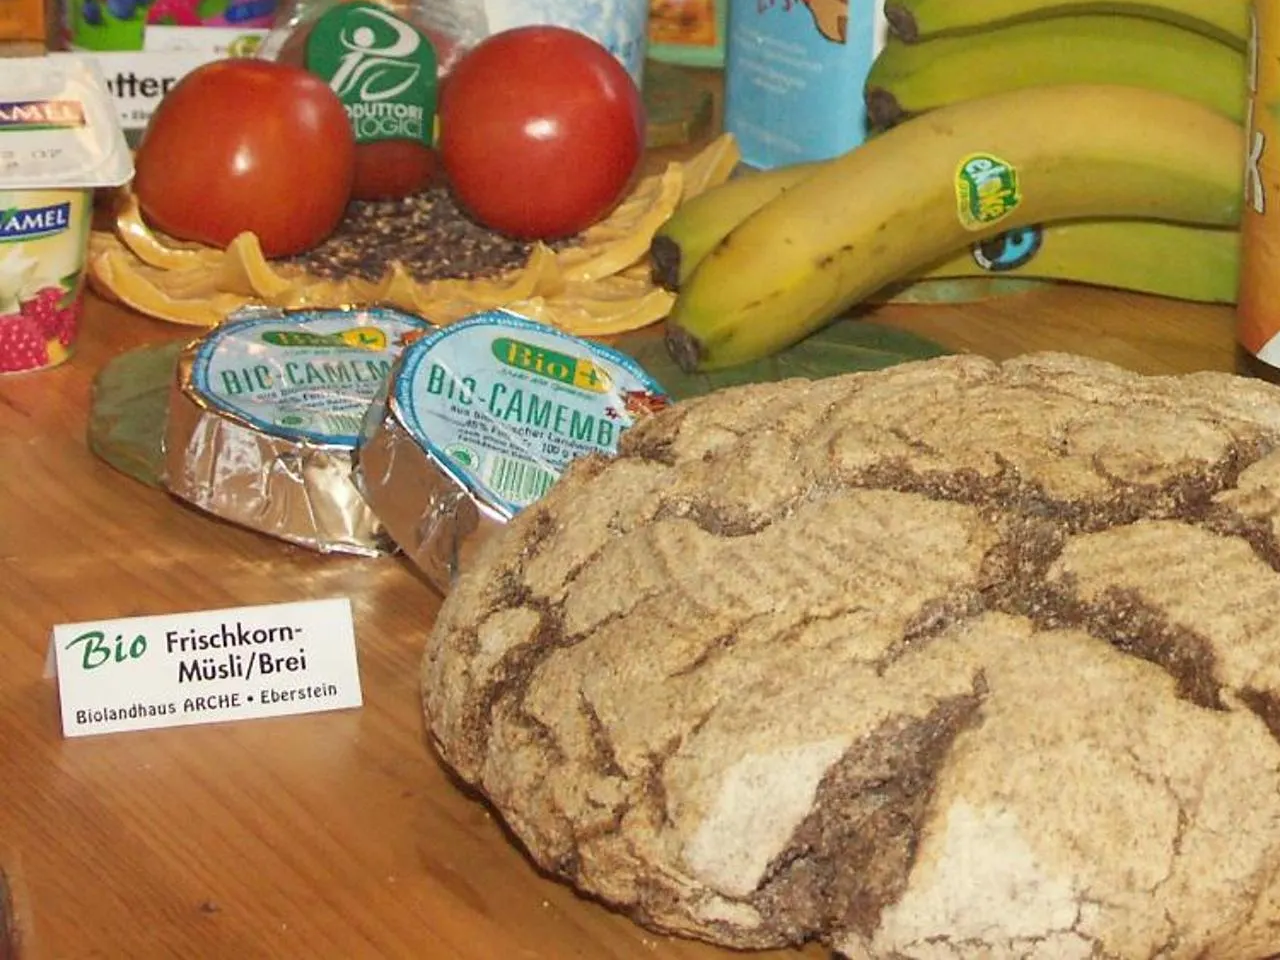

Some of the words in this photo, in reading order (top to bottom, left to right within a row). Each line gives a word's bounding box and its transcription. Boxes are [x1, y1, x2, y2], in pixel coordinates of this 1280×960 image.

[4, 207, 67, 232] AMEL
[506, 341, 568, 381] Bio
[64, 629, 148, 671] Bio
[165, 621, 303, 654] Frischkorn-
[177, 647, 307, 684] Müsli/Brei
[75, 699, 177, 725] Biolandhaus
[183, 693, 242, 713] ARCHE
[260, 682, 338, 705] Eberstein
